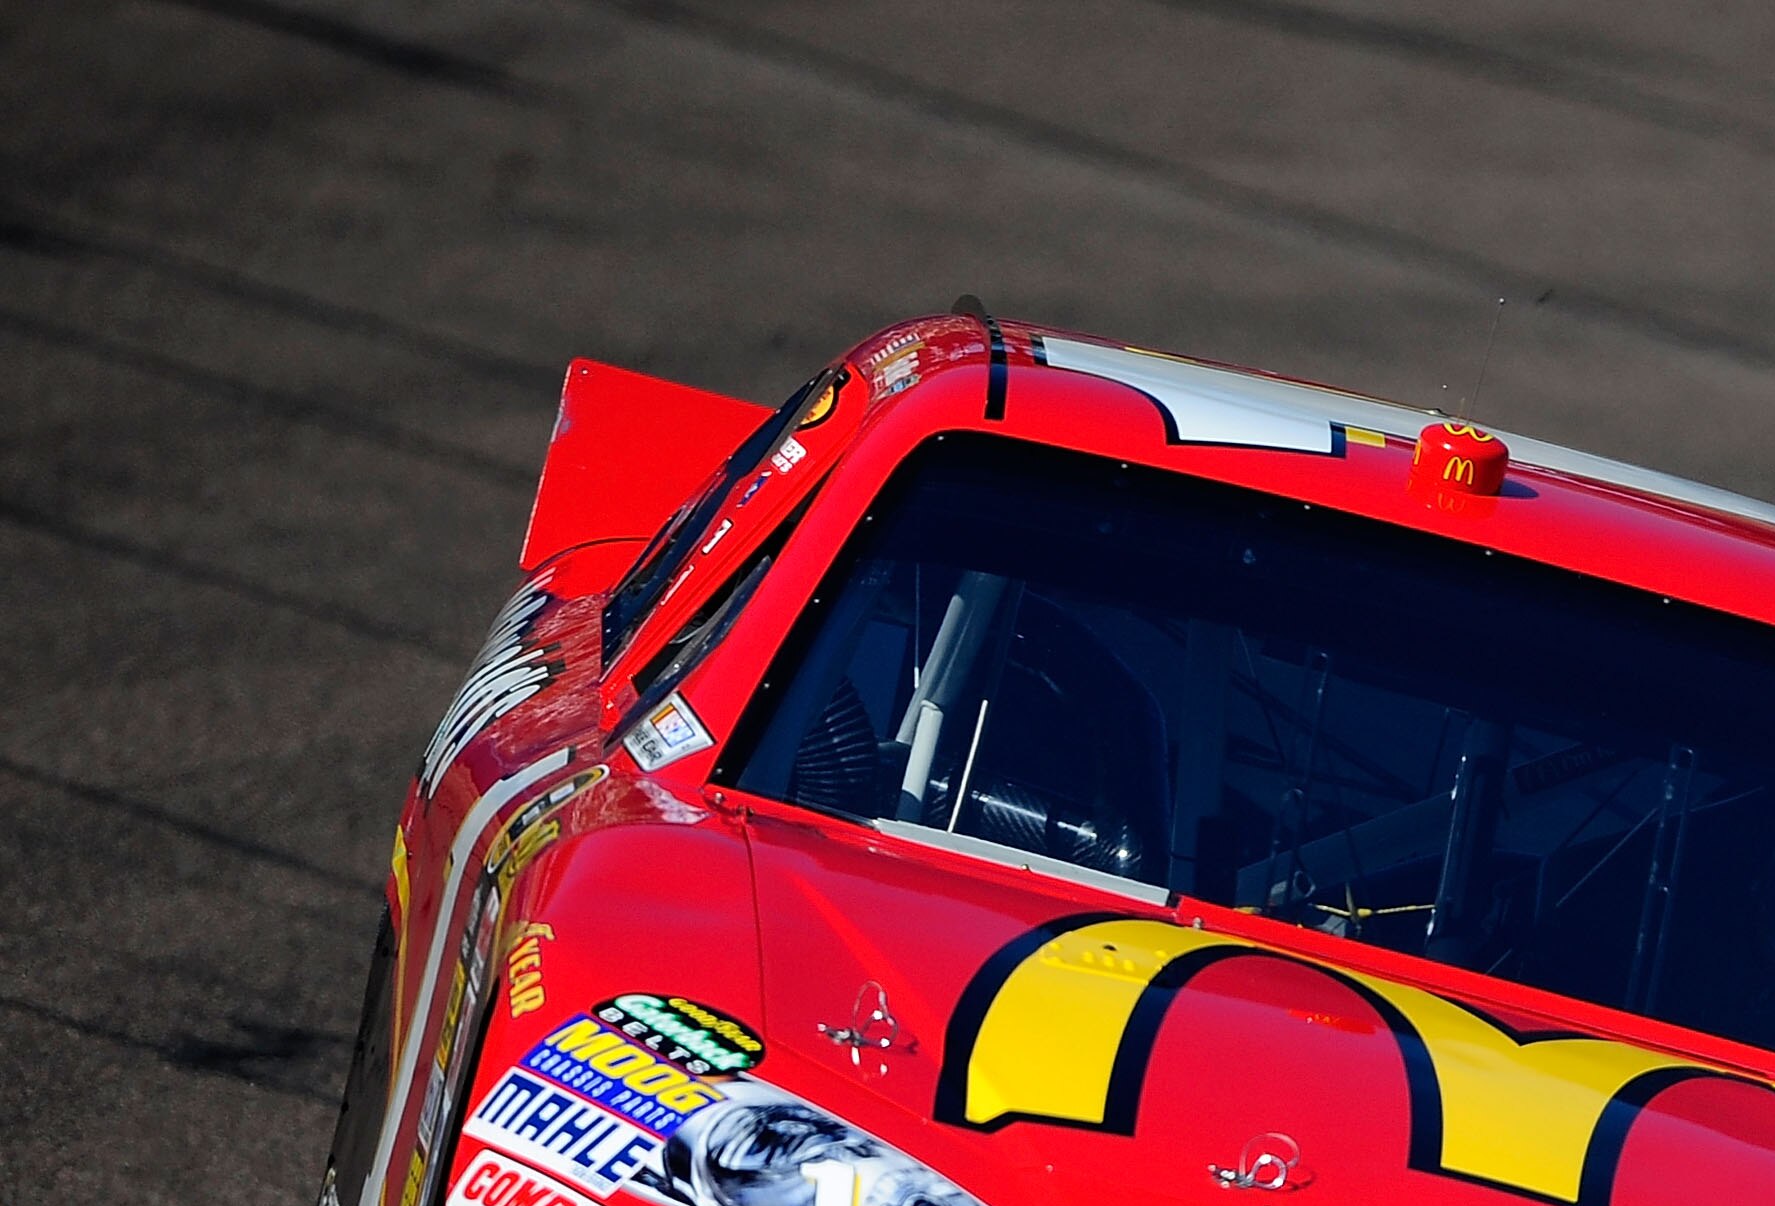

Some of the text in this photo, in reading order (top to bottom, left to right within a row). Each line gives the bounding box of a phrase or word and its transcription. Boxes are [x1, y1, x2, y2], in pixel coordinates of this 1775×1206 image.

[543, 1018, 730, 1114] MOOG
[598, 1006, 711, 1075] BELTS
[477, 1072, 656, 1184] MAHLE
[529, 1049, 676, 1131] CHASSIS PARTS
